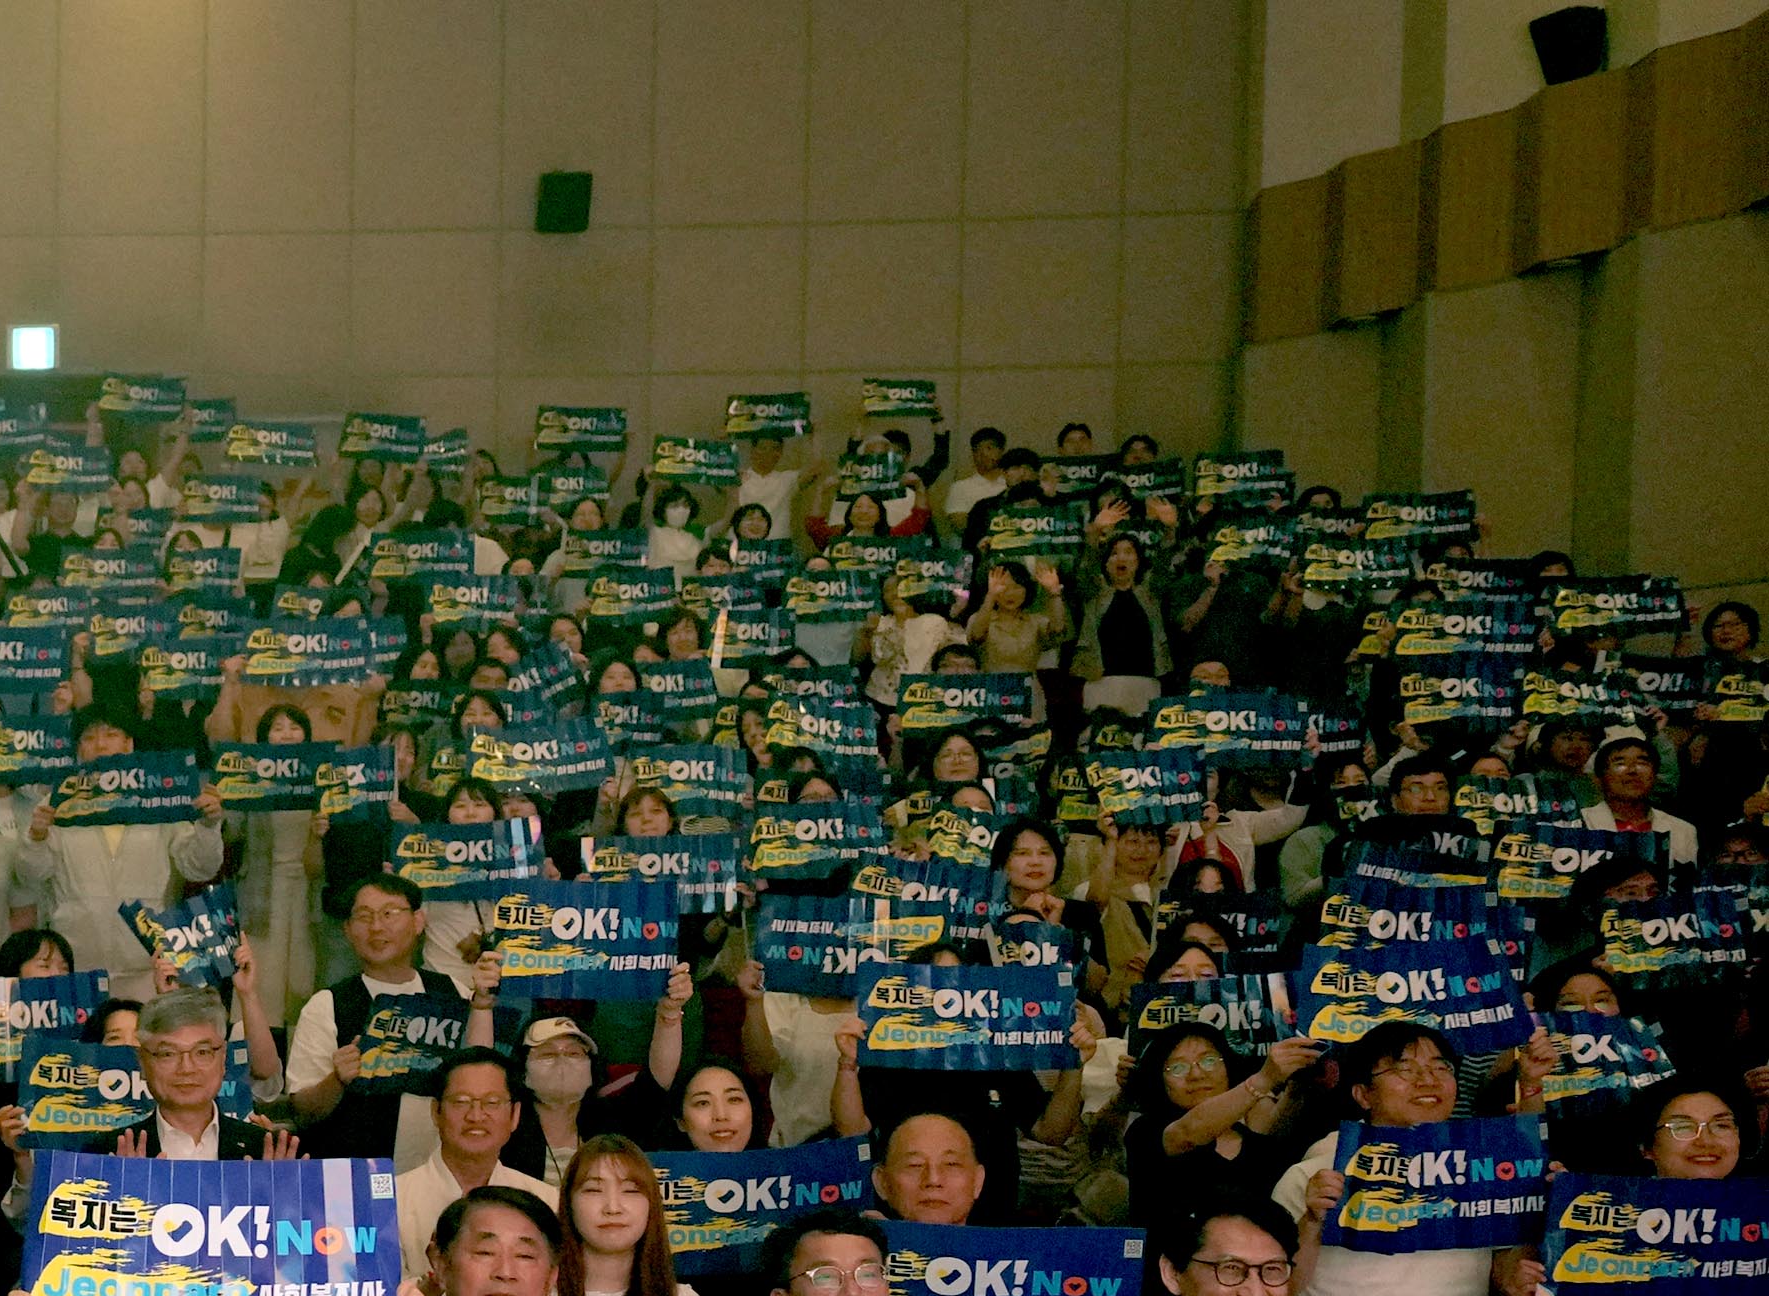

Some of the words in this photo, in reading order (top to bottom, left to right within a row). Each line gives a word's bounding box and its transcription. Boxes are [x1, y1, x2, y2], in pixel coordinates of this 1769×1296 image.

[1204, 711, 1256, 736] OK!
[548, 907, 619, 940] OK!
[621, 918, 677, 941] Now
[1375, 969, 1446, 1003] OK!
[930, 989, 999, 1020] OK!
[1001, 999, 1061, 1016] Now
[50, 1197, 137, 1234] 복지는
[148, 1204, 270, 1258] OK!
[277, 1220, 377, 1255] Now
[922, 1257, 1027, 1296] OK!
[1032, 1270, 1121, 1296] Now
